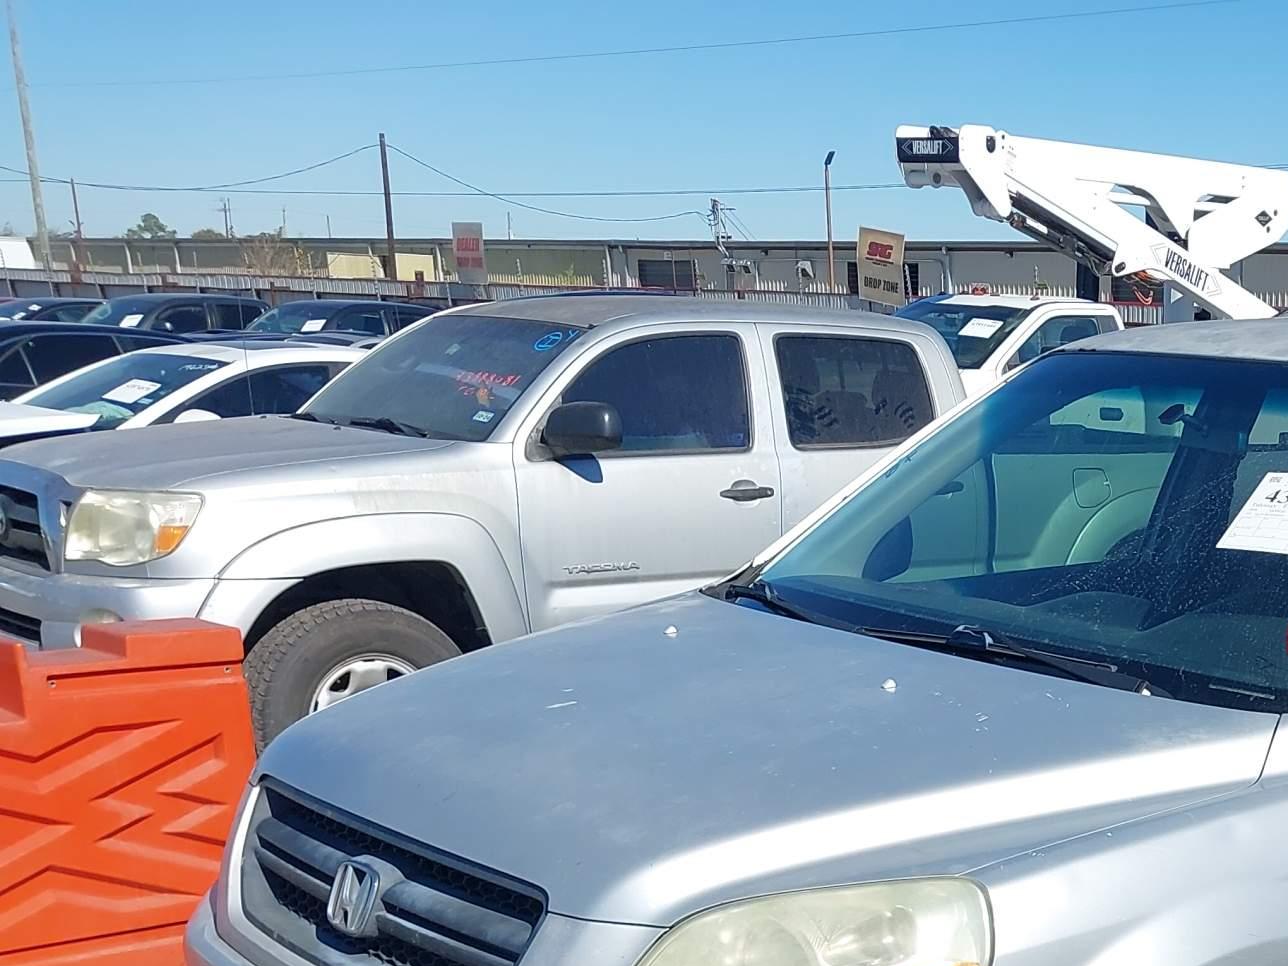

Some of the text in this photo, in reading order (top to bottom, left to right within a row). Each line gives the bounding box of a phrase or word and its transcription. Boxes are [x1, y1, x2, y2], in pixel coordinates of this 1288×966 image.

[912, 140, 943, 155] VERSALIFT
[1164, 247, 1210, 292] VERSALIFT
[864, 275, 899, 294] DROP ZONE
[562, 562, 640, 574] TACOMA
